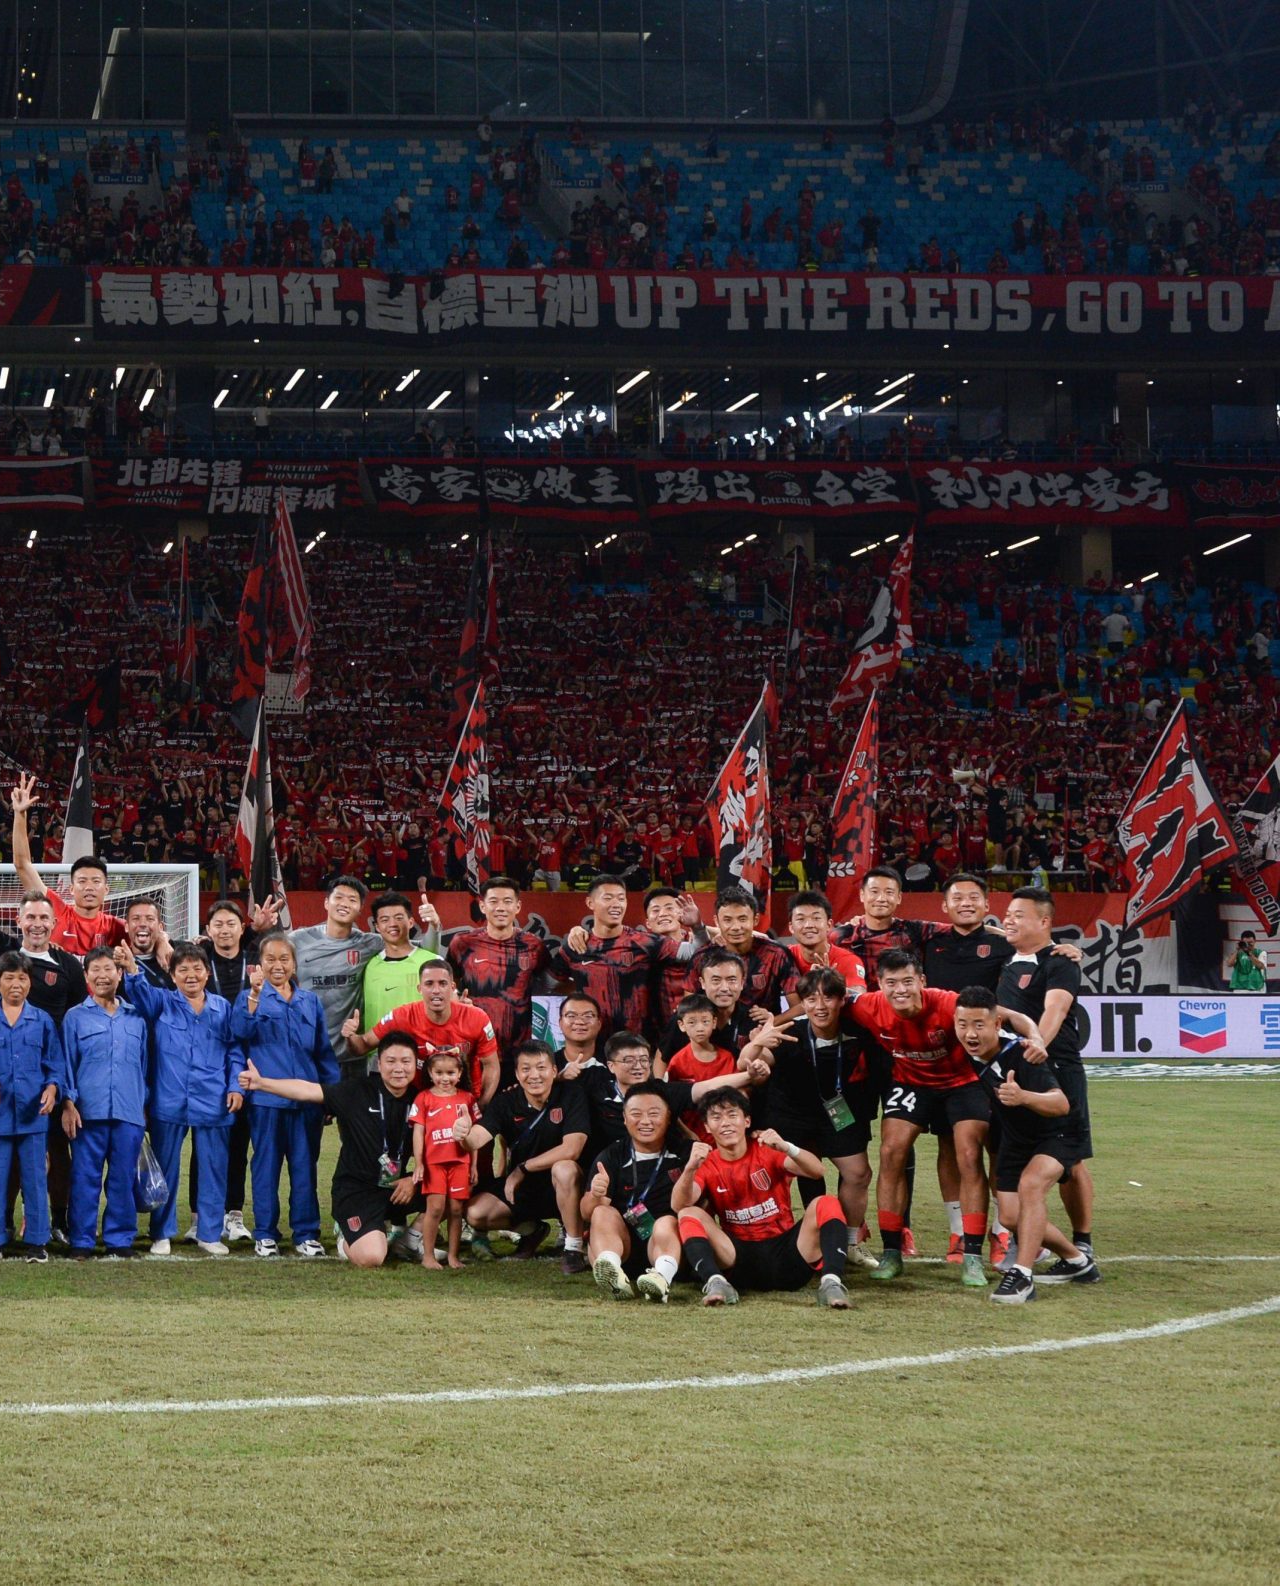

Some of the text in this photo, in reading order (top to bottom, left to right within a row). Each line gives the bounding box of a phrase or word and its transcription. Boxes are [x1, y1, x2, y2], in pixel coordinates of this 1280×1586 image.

[609, 275, 698, 329] UP
[714, 277, 848, 331] THE
[1065, 281, 1143, 333] GO
[1158, 281, 1244, 333] TO
[117, 457, 243, 487] 北部先锋
[1179, 1000, 1227, 1011] Chevron
[1101, 1002, 1153, 1052] IT.
[886, 1087, 917, 1112] 24
[725, 1197, 778, 1222] 成都蓉城
